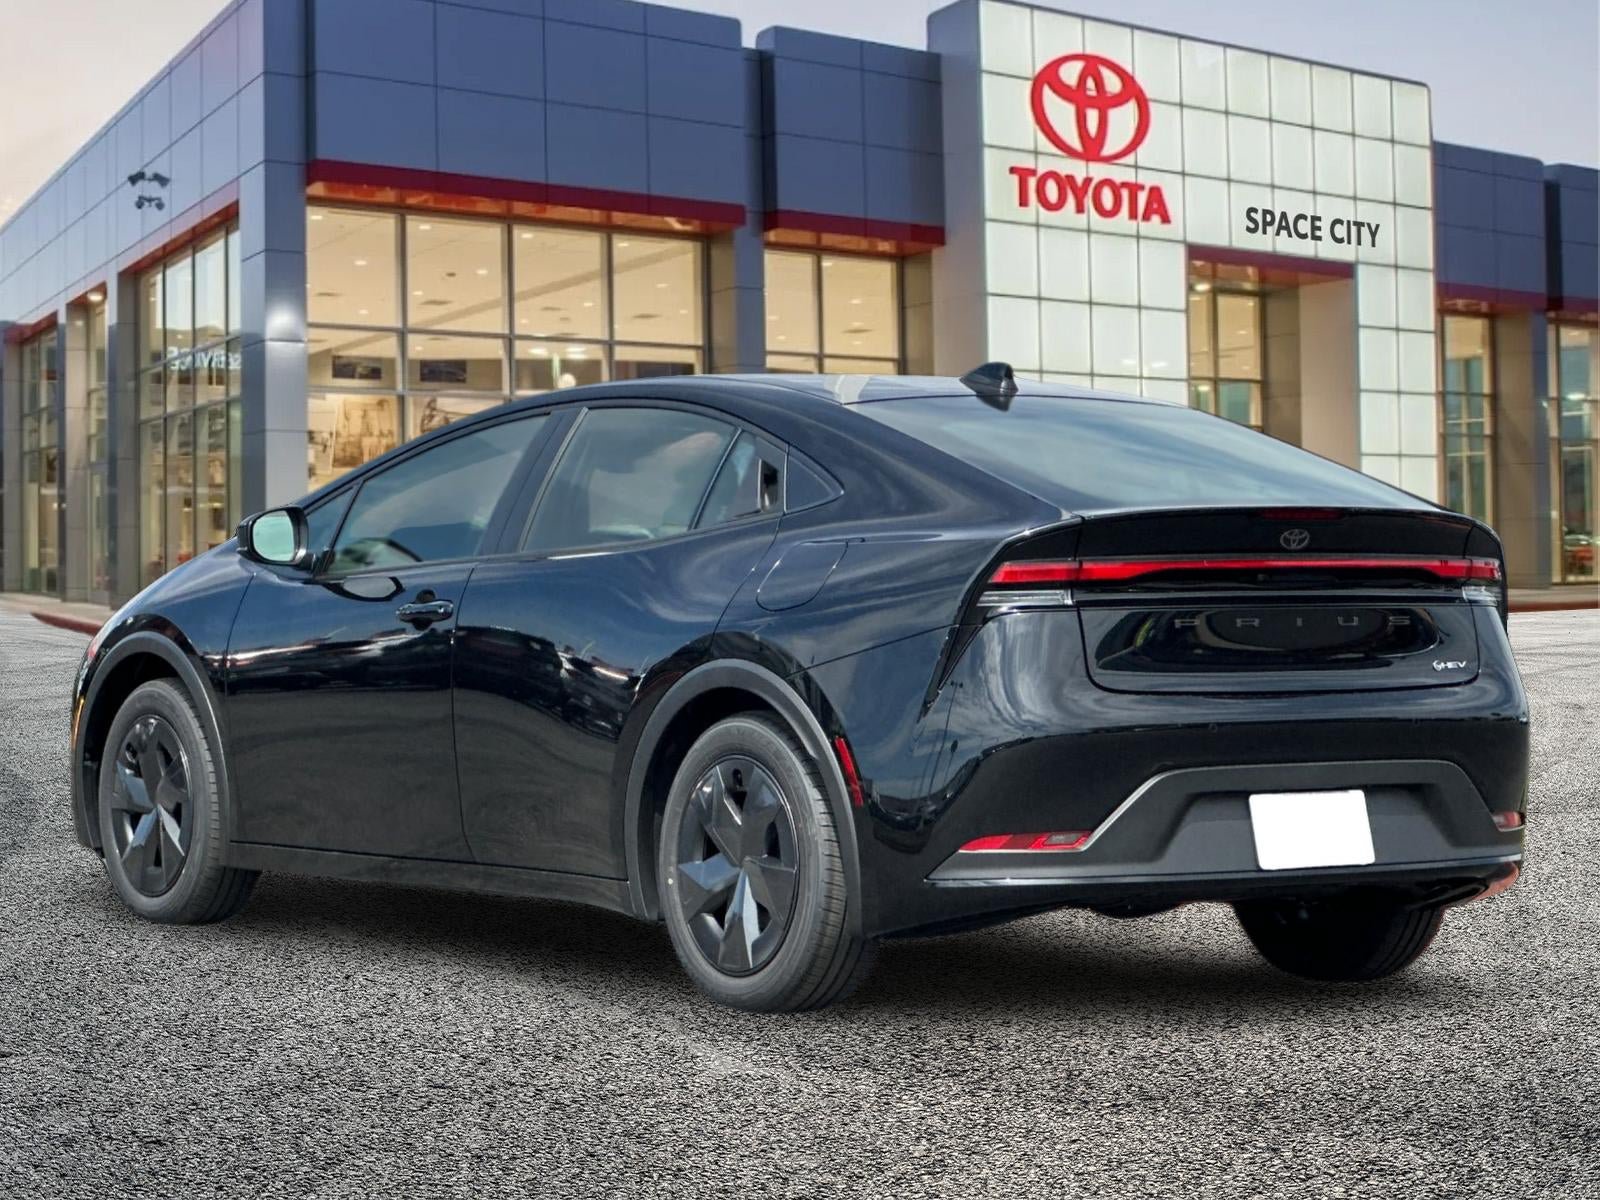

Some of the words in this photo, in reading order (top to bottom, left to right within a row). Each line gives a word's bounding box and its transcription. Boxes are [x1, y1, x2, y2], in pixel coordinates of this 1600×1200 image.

[1009, 166, 1171, 224] TOYOTA
[1245, 207, 1322, 242] SPACE
[1330, 218, 1380, 248] CITY
[1174, 615, 1411, 628] PRIUS
[1440, 660, 1467, 669] HEV
